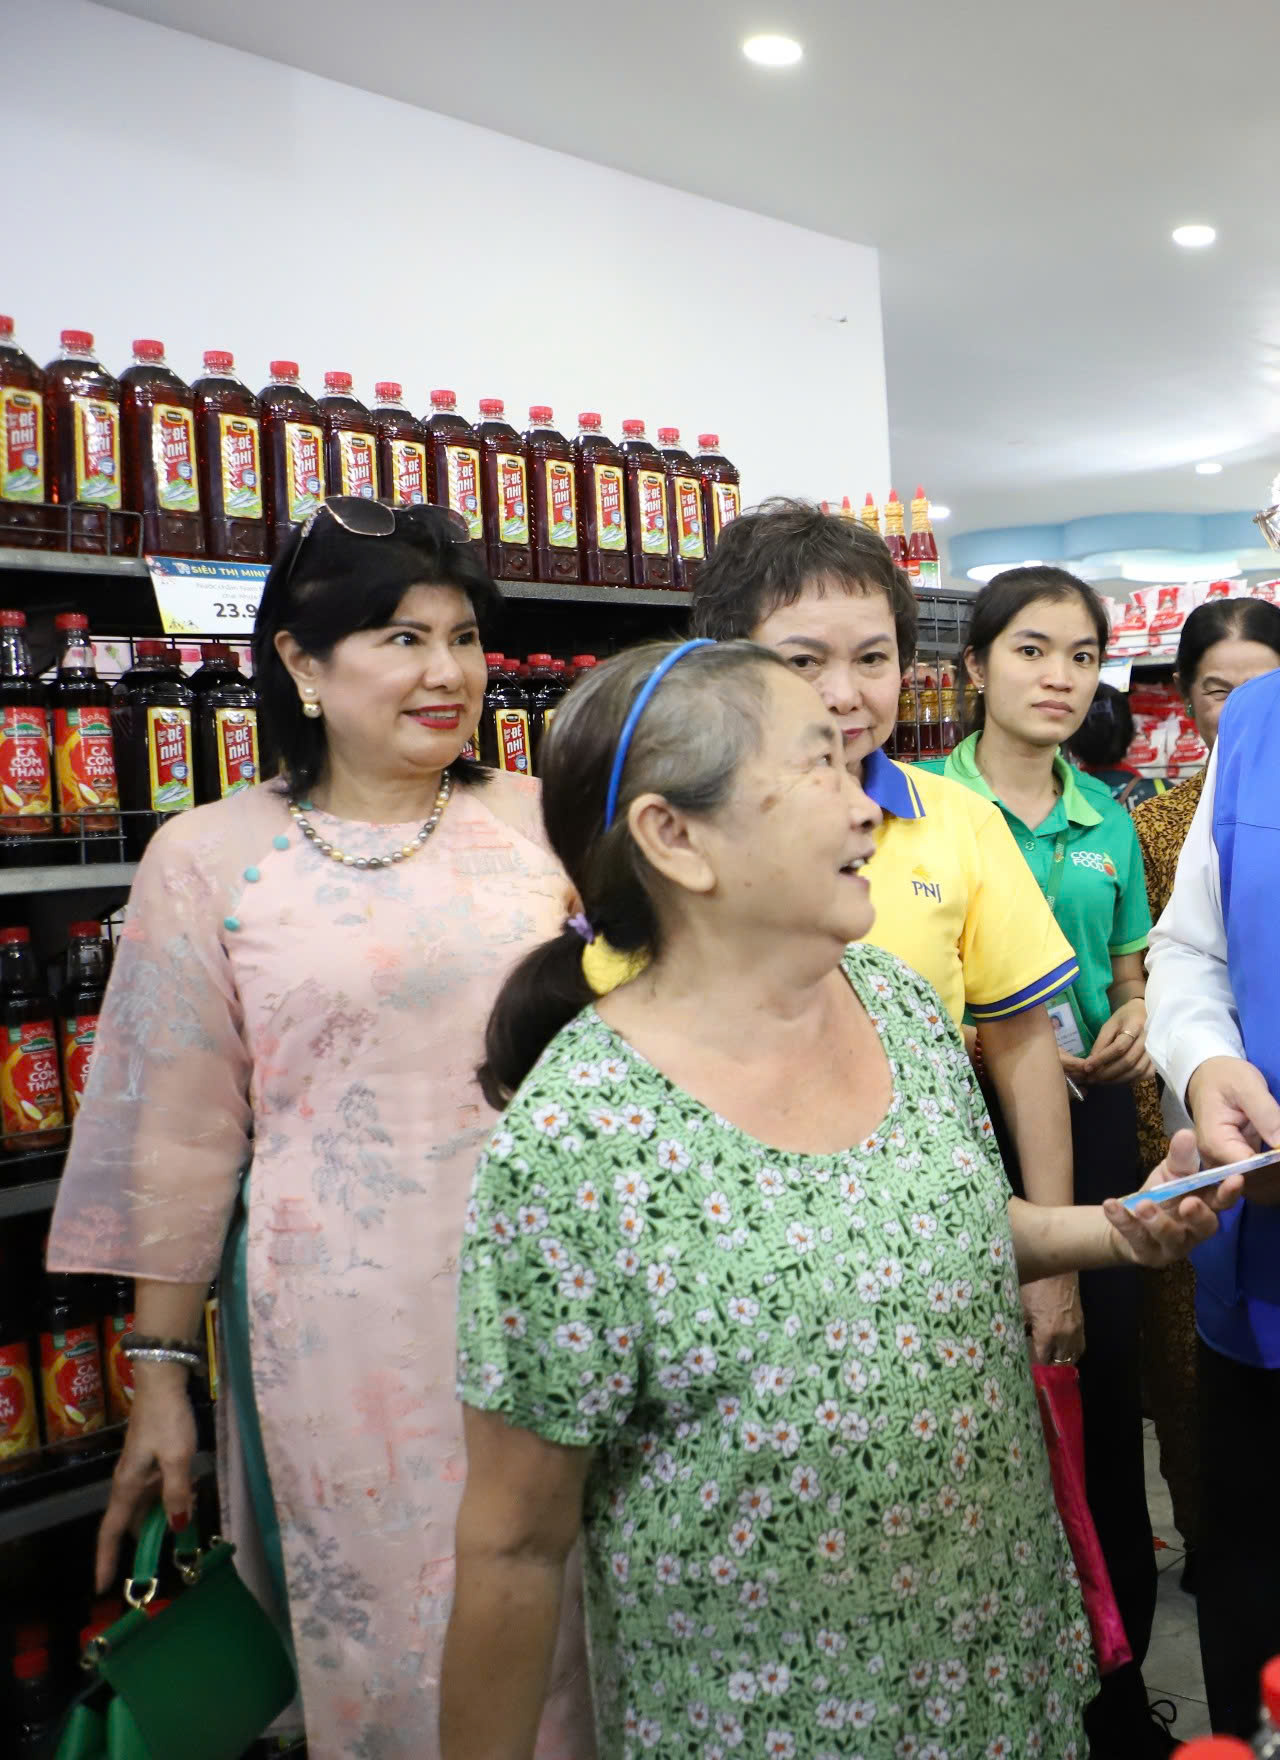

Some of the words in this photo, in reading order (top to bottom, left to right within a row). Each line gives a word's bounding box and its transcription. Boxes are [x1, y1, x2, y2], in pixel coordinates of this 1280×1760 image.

[191, 565, 217, 575] SIÊU
[9, 767, 45, 778] THAN
[84, 766, 115, 776] THAN
[912, 880, 942, 904] PNJ
